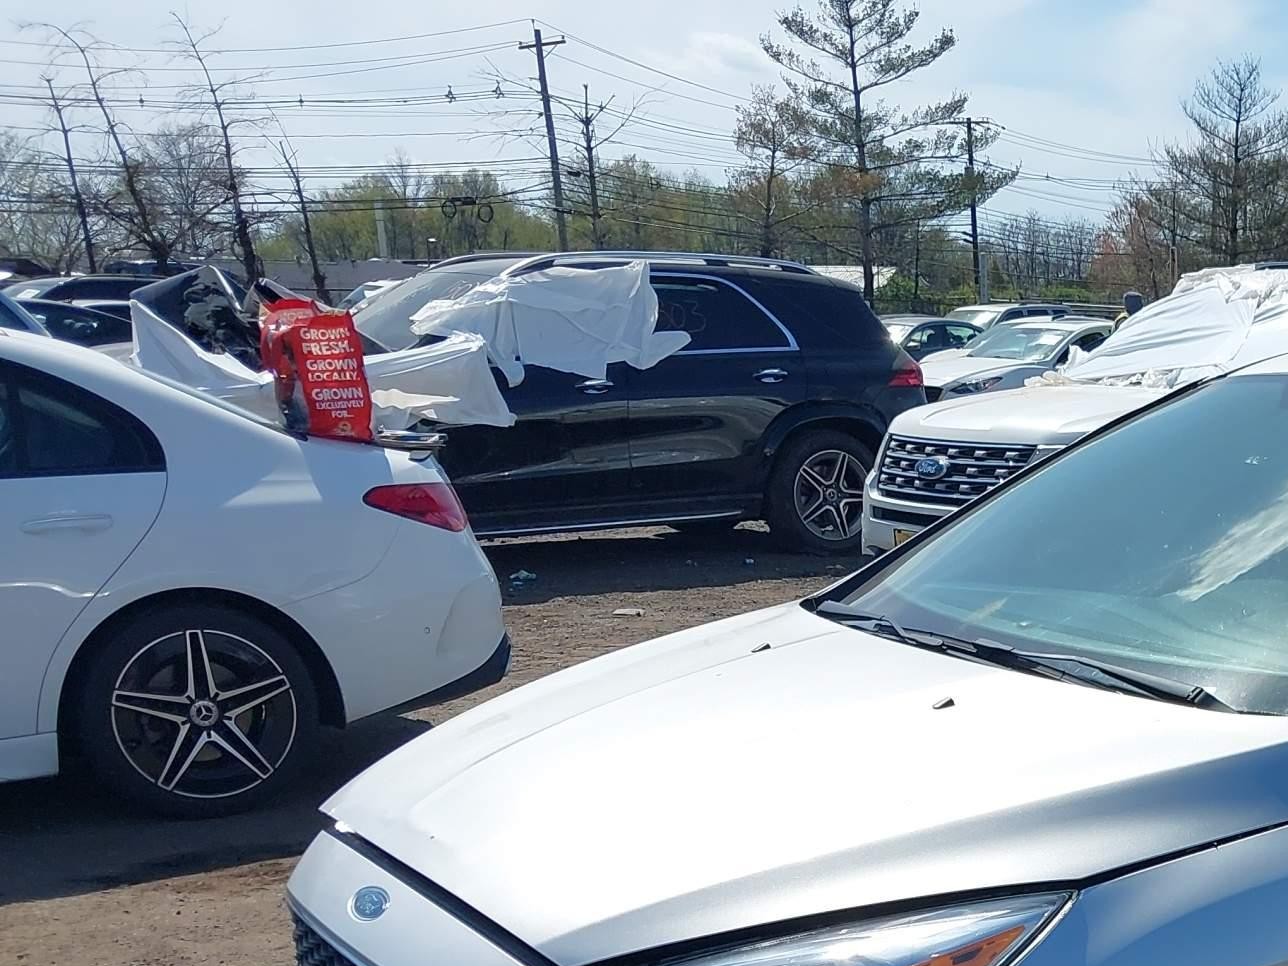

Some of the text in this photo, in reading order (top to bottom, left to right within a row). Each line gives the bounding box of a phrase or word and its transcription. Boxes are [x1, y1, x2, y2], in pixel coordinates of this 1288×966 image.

[300, 328, 350, 340] GROWN
[302, 340, 354, 355] FRESH.
[306, 358, 357, 370] GROWN
[308, 372, 360, 381] LOCALLY.
[312, 387, 363, 400] GROWN
[316, 400, 365, 409] EXCLUSIVELY
